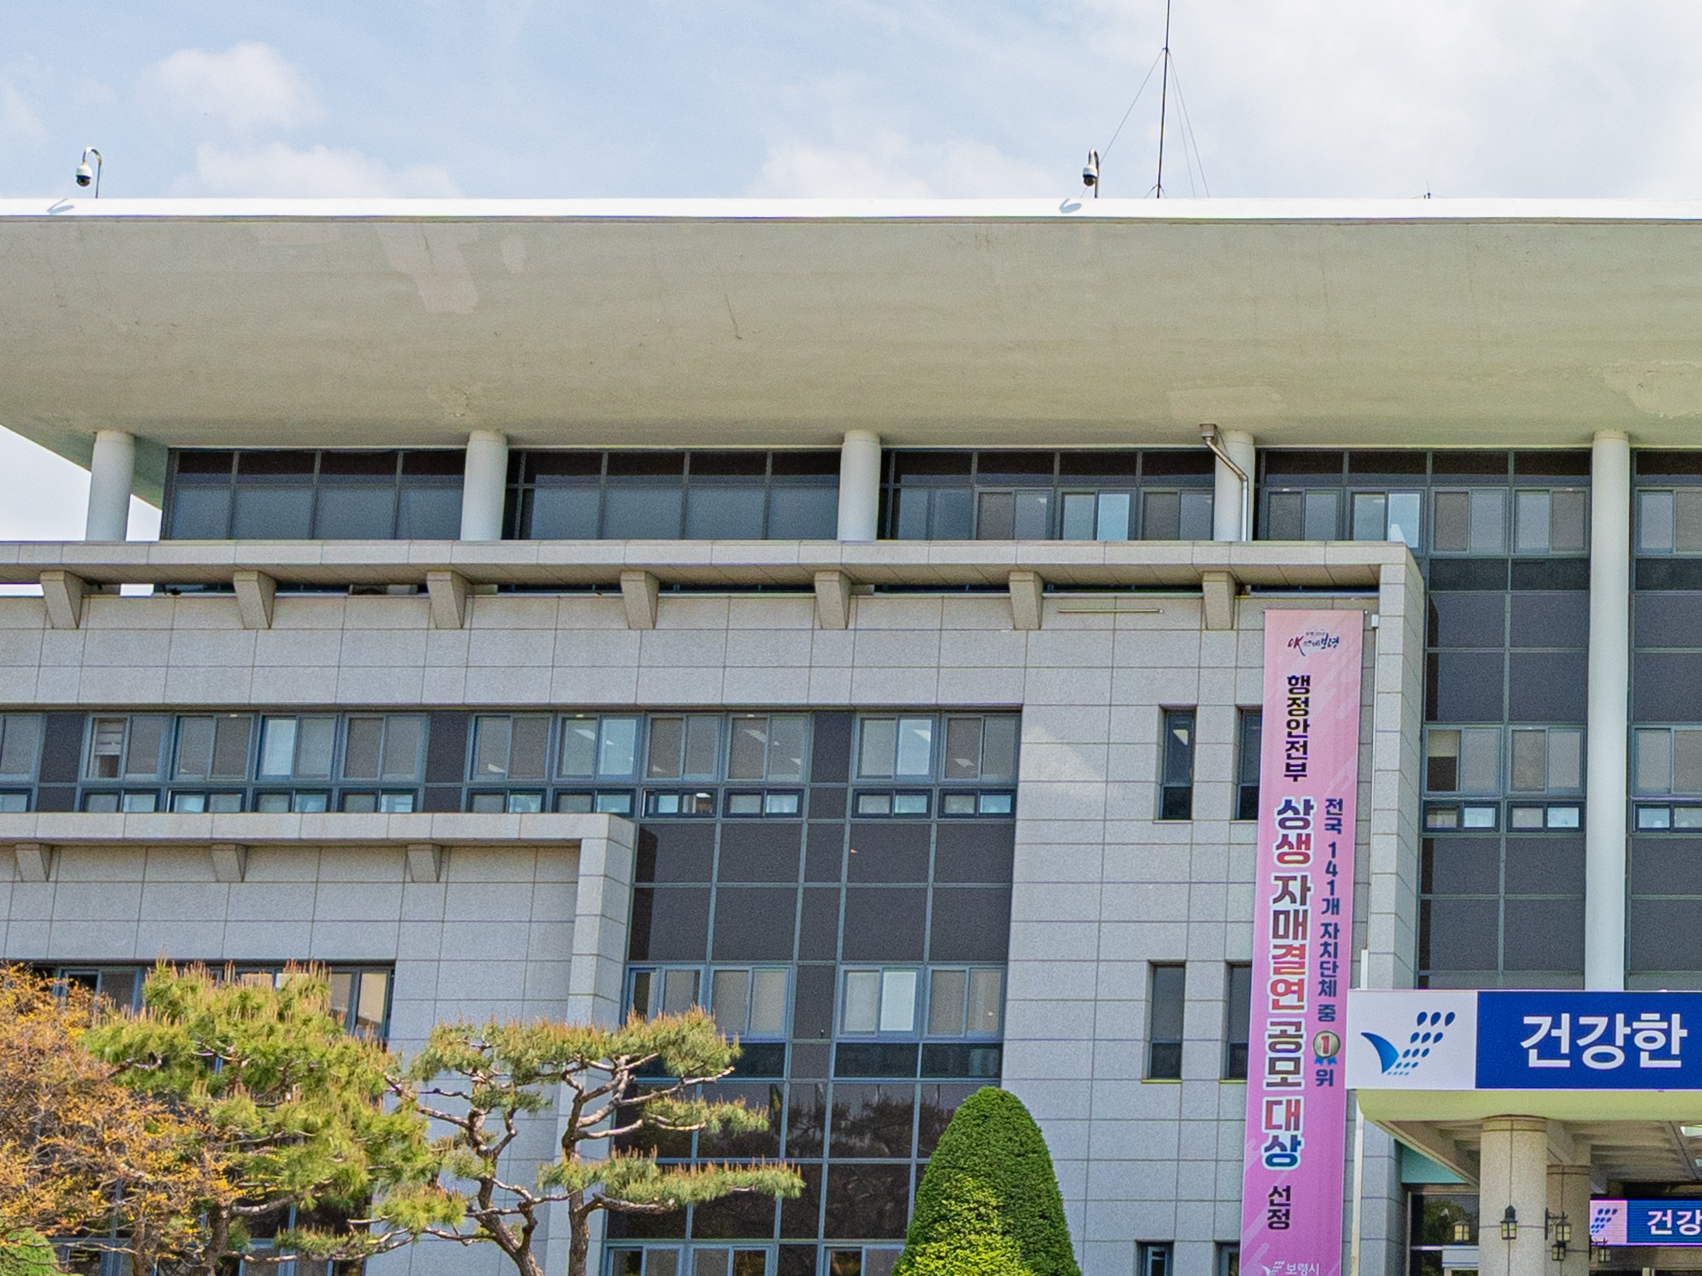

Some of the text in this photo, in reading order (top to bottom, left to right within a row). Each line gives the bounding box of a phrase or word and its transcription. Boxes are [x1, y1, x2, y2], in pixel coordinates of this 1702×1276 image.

[1284, 675, 1311, 782] 행정안전부
[1324, 798, 1343, 834] 전국
[1321, 841, 1340, 916] 141개
[1263, 798, 1314, 1167] 상생 자매결연 공모 대상
[1318, 922, 1340, 997] 자치단체
[1317, 1004, 1336, 1022] 중
[1520, 1012, 1688, 1070] 건강한
[1267, 1185, 1292, 1230] 선정
[1285, 1263, 1320, 1276] 보령시
